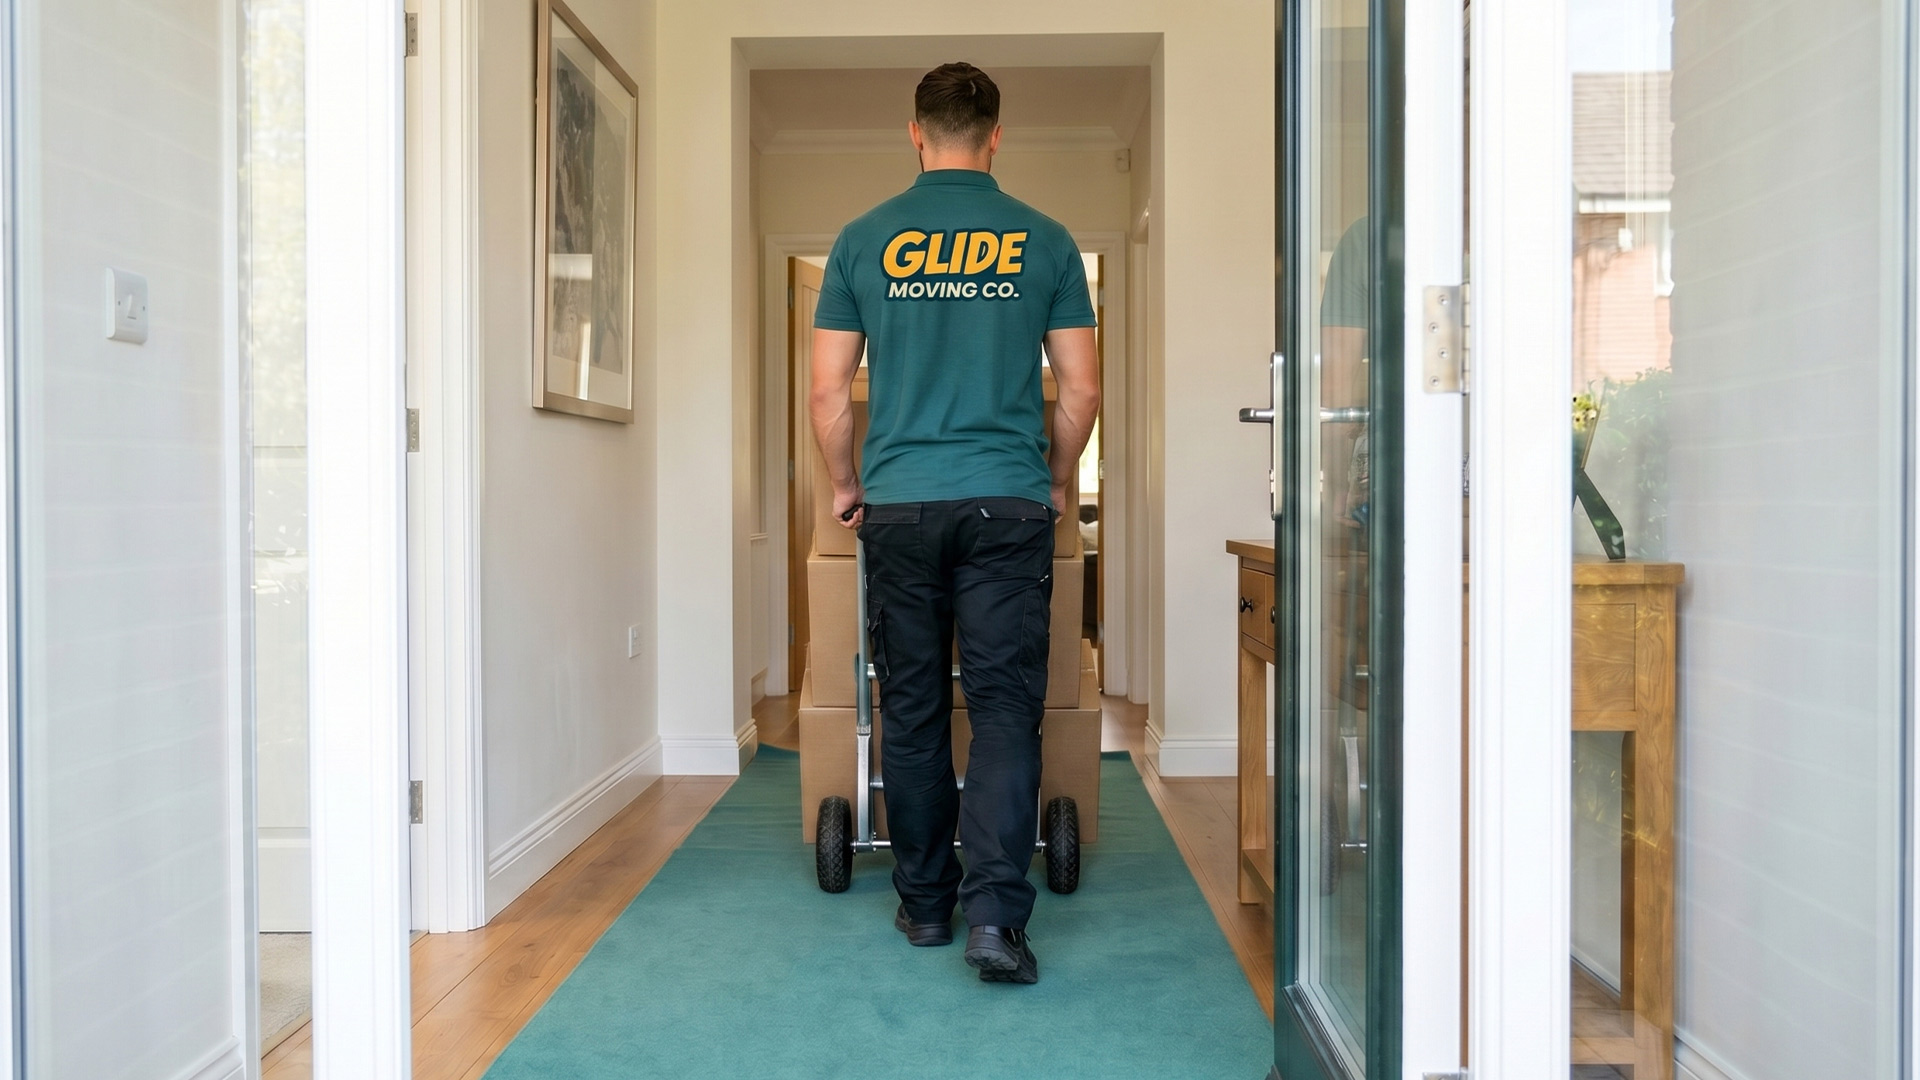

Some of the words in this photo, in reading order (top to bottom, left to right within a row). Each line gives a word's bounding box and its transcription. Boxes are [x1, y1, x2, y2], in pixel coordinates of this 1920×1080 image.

[883, 230, 1028, 279] GLIDE
[888, 281, 978, 298] MOVING
[982, 281, 1020, 298] CO.
